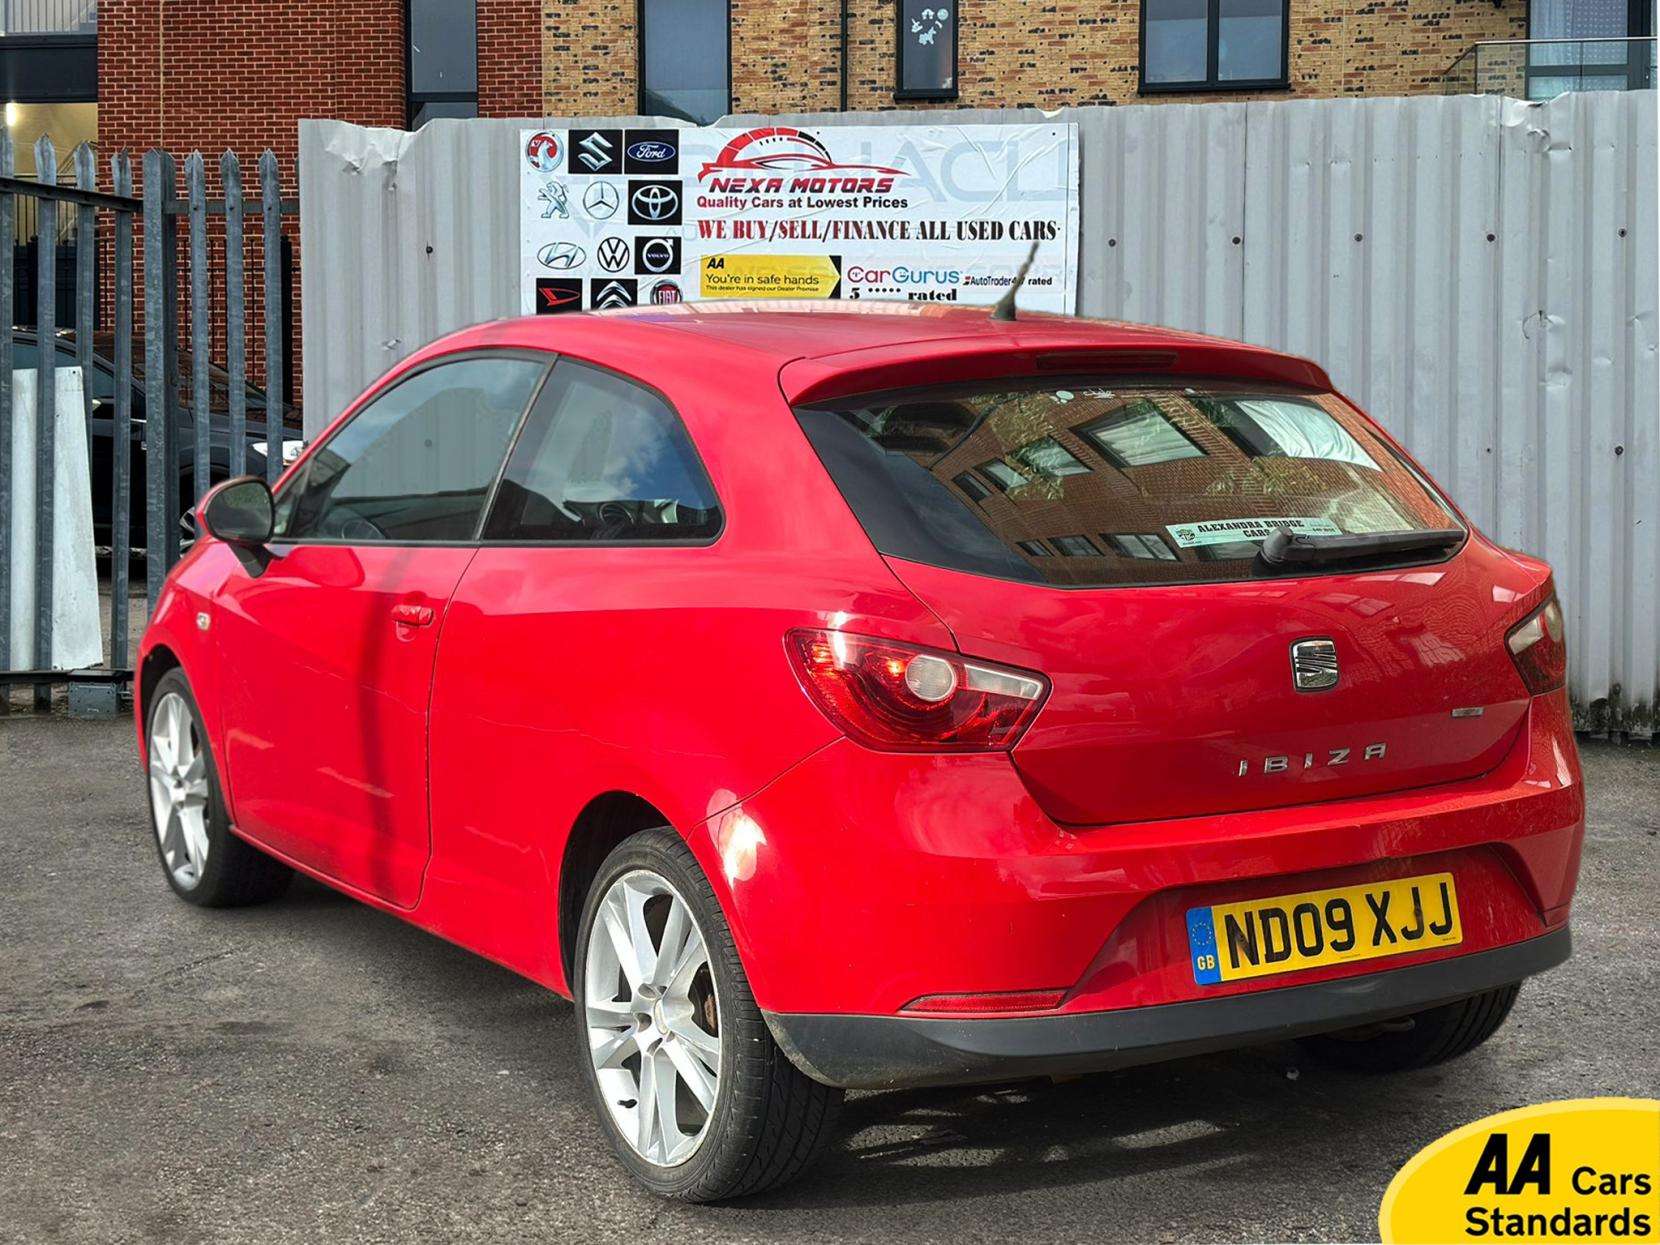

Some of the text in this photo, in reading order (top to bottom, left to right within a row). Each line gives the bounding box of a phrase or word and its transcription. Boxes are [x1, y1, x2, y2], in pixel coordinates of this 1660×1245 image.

[636, 144, 665, 159] Ford
[708, 178, 895, 193] NEXA MOTORS
[697, 196, 908, 210] Quality Cars at Lowest Prices
[697, 220, 727, 239] WE
[733, 220, 911, 242] BUY/SELL/FINANCE
[915, 220, 951, 240] ALL
[956, 220, 1003, 240] USED
[1008, 220, 1057, 240] CARS
[706, 257, 725, 269] AA
[706, 274, 819, 285] You're in safe hands
[847, 266, 960, 284] CarGurus
[1028, 277, 1053, 286] rated
[849, 287, 957, 300] 5 rated
[1197, 521, 1263, 533] ALEXANDRA
[1263, 520, 1305, 530] BRIDGE
[1238, 743, 1387, 776] IBIZA
[1224, 882, 1453, 969] ND09 XJJ
[1197, 955, 1215, 971] GB
